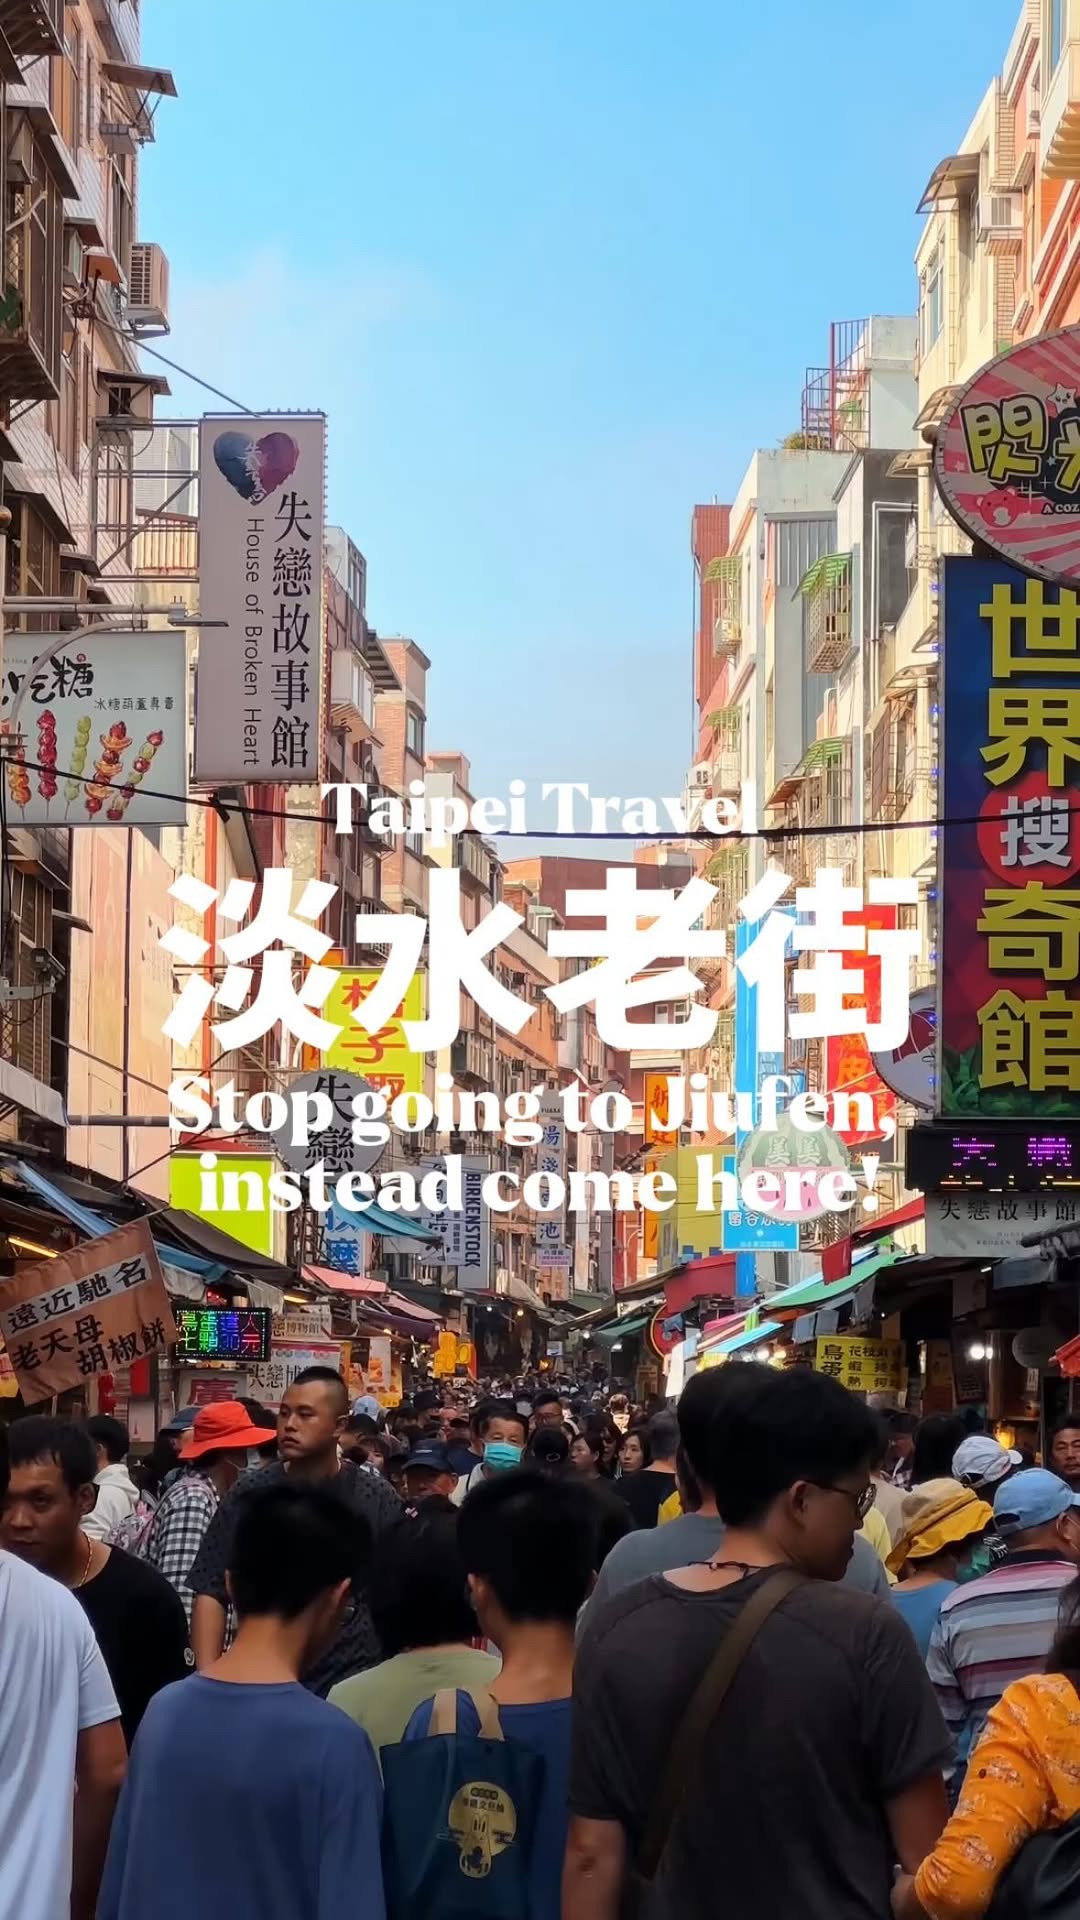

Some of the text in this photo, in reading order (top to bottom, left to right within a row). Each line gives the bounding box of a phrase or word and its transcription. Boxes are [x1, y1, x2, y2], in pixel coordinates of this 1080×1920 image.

[246, 518, 265, 582] House
[246, 594, 264, 615] of
[270, 491, 312, 769] 失戀故事館
[0, 655, 95, 706] 吃糖
[244, 626, 263, 696] Broken
[243, 708, 262, 766] Heart
[978, 579, 1080, 1094] 世界搜奇館
[465, 1173, 481, 1268] BIRKENSTOCK
[940, 1198, 1076, 1222] 失戀故事館
[8, 1258, 147, 1334] 遠近馳名
[12, 1314, 105, 1371] 老天母
[75, 1317, 166, 1376] 胡椒餅
